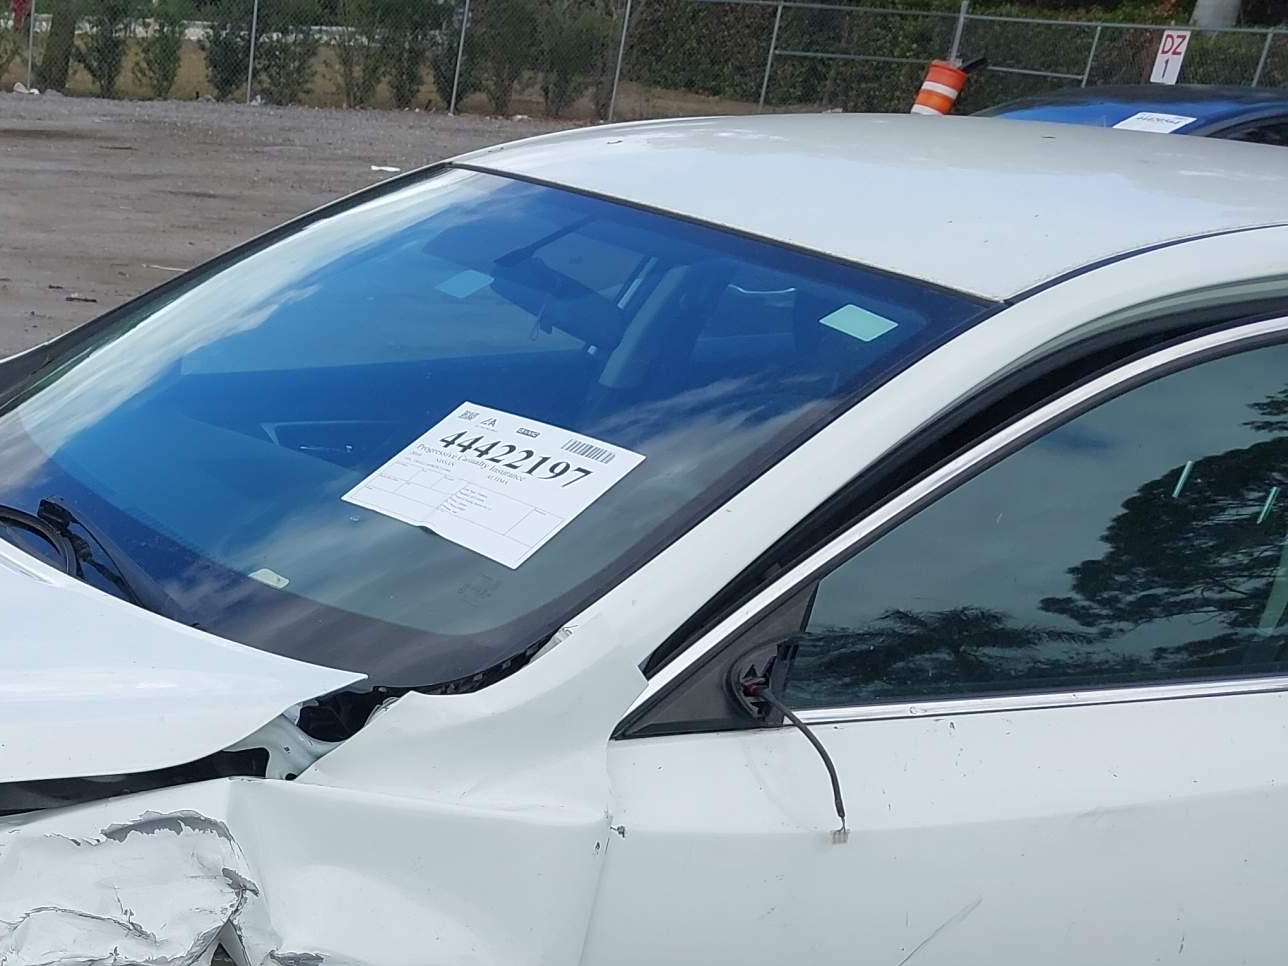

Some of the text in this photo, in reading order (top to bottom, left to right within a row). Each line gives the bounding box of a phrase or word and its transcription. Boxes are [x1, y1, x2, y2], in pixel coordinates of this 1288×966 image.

[1160, 33, 1187, 56] DZ
[1161, 57, 1170, 79] 1
[440, 430, 593, 488] 44422197
